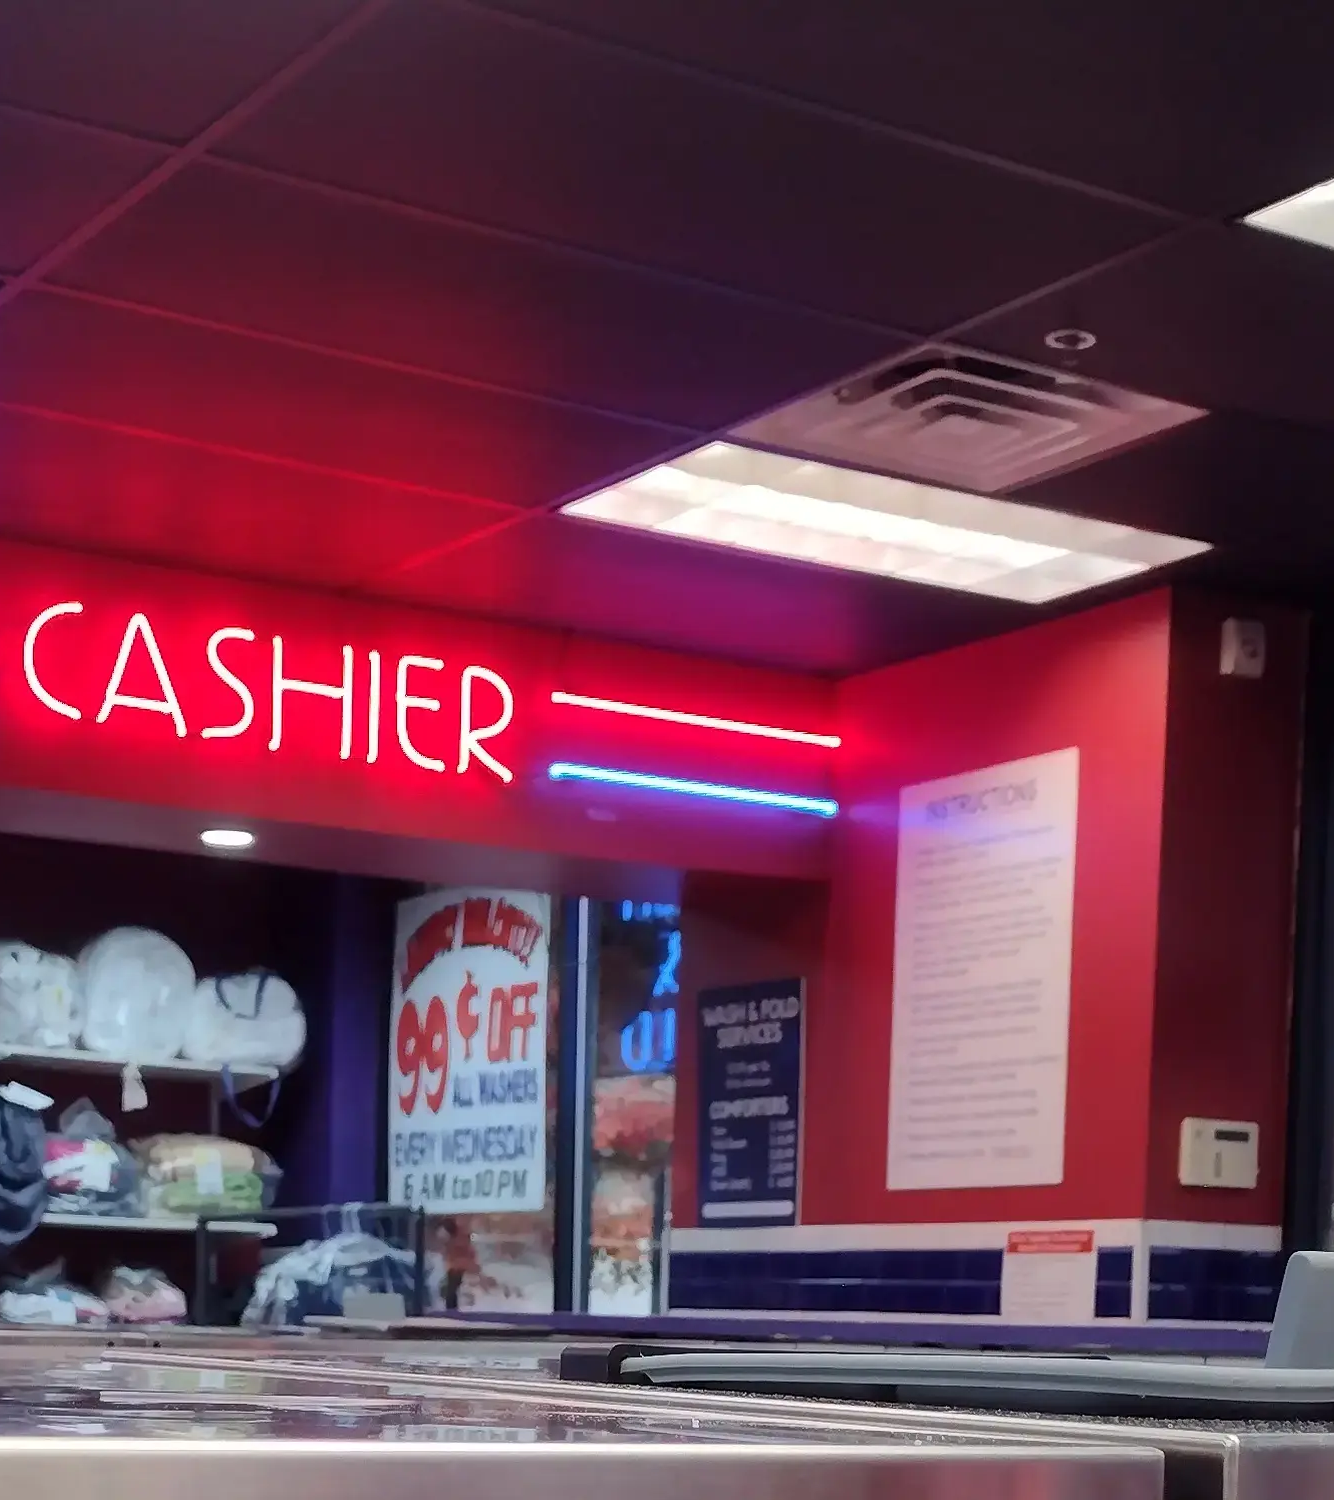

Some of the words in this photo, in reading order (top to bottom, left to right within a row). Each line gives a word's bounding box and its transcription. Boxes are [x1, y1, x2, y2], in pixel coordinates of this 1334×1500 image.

[23, 601, 515, 784] CASHIER
[486, 981, 538, 1065] OFF
[452, 1072, 474, 1108] ALL
[478, 1068, 538, 1106] WASHERS
[394, 1133, 436, 1167] EVERY
[441, 1126, 538, 1163] WEDNESDAY
[418, 1172, 446, 1200] AM
[475, 1173, 493, 1197] 10
[498, 1169, 528, 1198] PM
